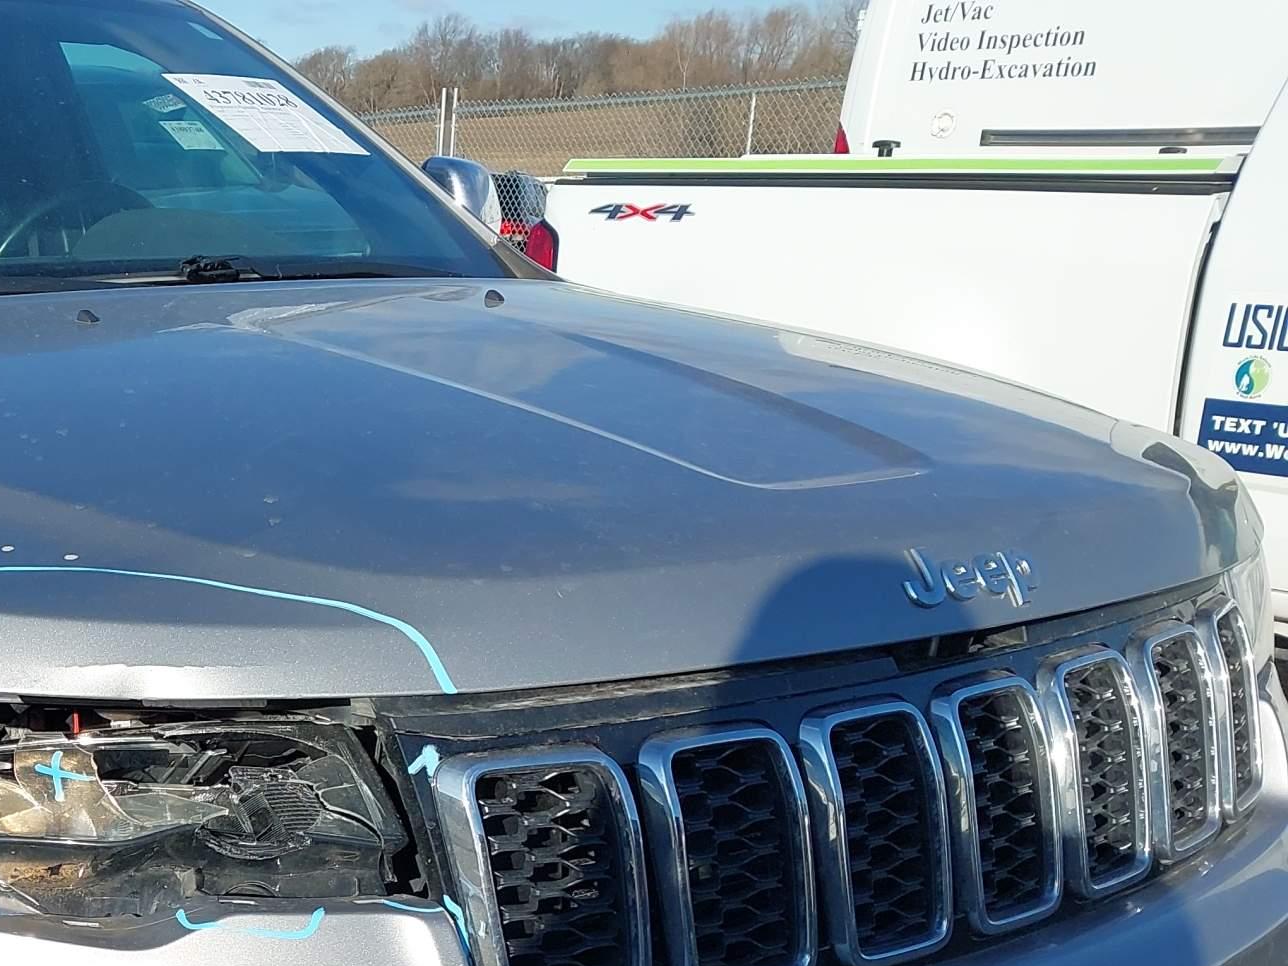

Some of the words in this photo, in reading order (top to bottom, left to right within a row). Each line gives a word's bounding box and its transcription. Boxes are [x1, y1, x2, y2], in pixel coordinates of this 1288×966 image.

[920, 0, 994, 24] Jet/Vac
[918, 32, 971, 52] Video
[976, 26, 1085, 55] Inspection
[909, 56, 1097, 84] Hydro-Excavation
[203, 89, 298, 109] 43781028
[1212, 415, 1266, 436] TEXT
[901, 548, 1038, 609] Jeep
